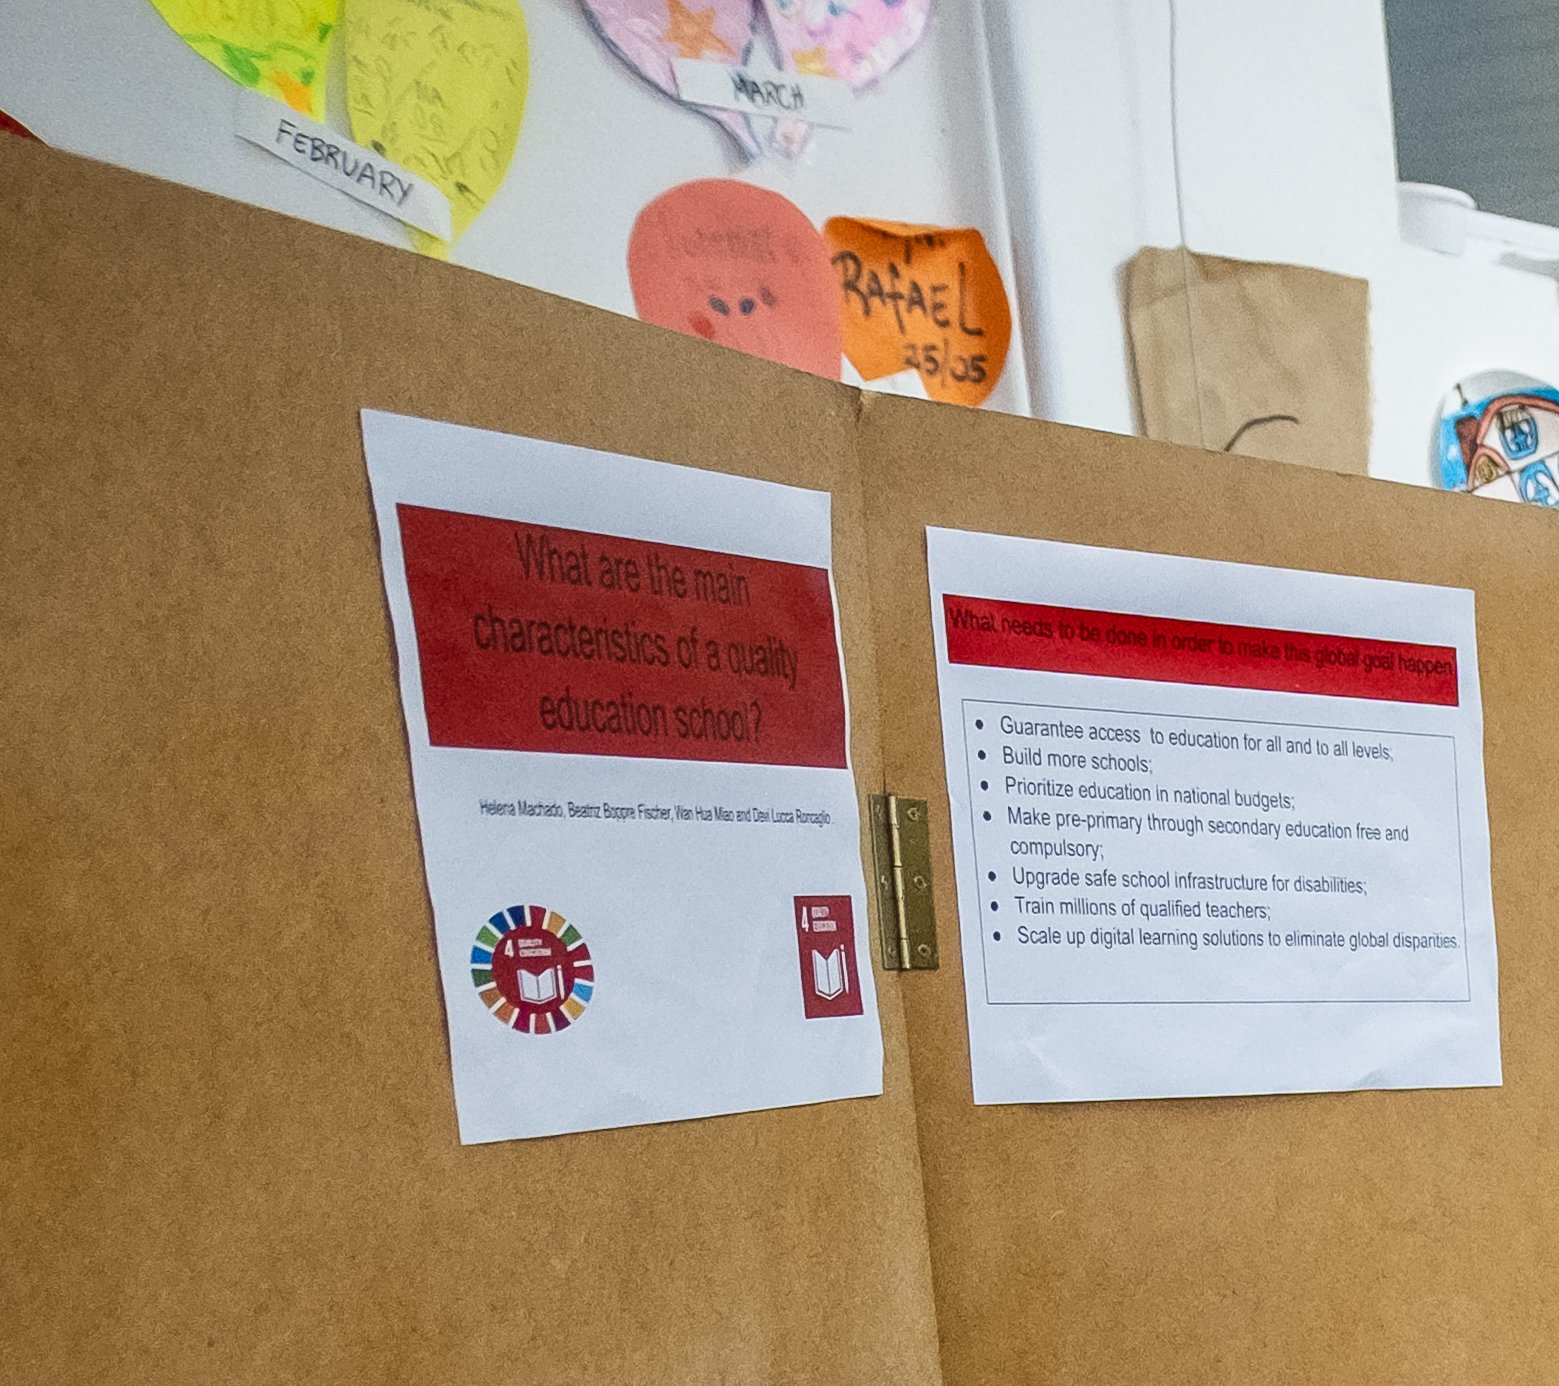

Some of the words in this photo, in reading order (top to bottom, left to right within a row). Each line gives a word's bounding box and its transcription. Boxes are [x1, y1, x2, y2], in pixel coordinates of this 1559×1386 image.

[732, 73, 805, 109] MARCH
[276, 118, 414, 206] FEBRUARY
[515, 533, 591, 586] What
[599, 552, 640, 592] are
[647, 553, 686, 599] the
[694, 562, 750, 608] main
[474, 604, 669, 667] characteristics
[678, 630, 699, 669] of
[706, 638, 720, 669] a
[729, 636, 798, 690] quality
[949, 608, 997, 633] What
[1001, 616, 1053, 639] needs
[1059, 620, 1075, 641] to
[1080, 622, 1101, 643] be
[1106, 624, 1147, 647] done
[1152, 629, 1167, 650] in
[1171, 629, 1215, 654] order
[1219, 634, 1234, 657] to
[1238, 639, 1280, 660] make
[1284, 642, 1311, 664] this
[1315, 645, 1359, 670] global
[1362, 651, 1395, 674] goal
[1399, 653, 1453, 678] happen
[540, 687, 669, 738] education
[674, 701, 762, 743] school?
[1000, 716, 1083, 738] Guarantee
[1089, 725, 1141, 743] access
[1150, 728, 1164, 744] to
[1169, 729, 1239, 749] education
[1244, 733, 1262, 750] for
[1267, 736, 1281, 752] all
[1287, 738, 1312, 755] and
[1316, 740, 1329, 756] to
[1334, 741, 1348, 757] all
[1353, 743, 1394, 762] levels;
[1003, 746, 1041, 766] Build
[1047, 752, 1086, 768] more
[1092, 753, 1153, 774] schools;
[1005, 776, 1073, 797] Prioritize
[1079, 782, 1150, 801] education
[1156, 785, 1168, 802] in
[1174, 788, 1230, 805] national
[1235, 789, 1295, 812] budgets;
[1007, 806, 1050, 826] Make
[1056, 811, 1142, 834] pre-primary
[1148, 813, 1203, 836] through
[1208, 818, 1281, 840] secondary
[1286, 821, 1352, 839] education
[1356, 822, 1381, 840] free
[1385, 825, 1409, 841] and
[1010, 840, 1104, 861] compulsory;
[1012, 866, 1079, 889] Upgrade
[1085, 869, 1117, 887] safe
[1122, 871, 1170, 889] school
[1174, 872, 1267, 891] infrastructure
[1272, 874, 1290, 891] for
[1294, 875, 1367, 896] disabilities;
[1014, 896, 1054, 915] Train
[1060, 897, 1117, 916] millions
[1121, 899, 1136, 917] of
[1140, 899, 1201, 920] qualified
[1206, 902, 1271, 921] teachers;
[505, 939, 514, 957] 4
[1018, 926, 1061, 945] Scale
[1066, 930, 1085, 948] up
[1090, 928, 1135, 949] digital
[1139, 928, 1198, 951] learning
[1203, 930, 1264, 947] solutions
[1268, 932, 1281, 947] to
[1285, 931, 1345, 948] eliminate
[1350, 932, 1389, 951] global
[1393, 932, 1460, 952] disparities.
